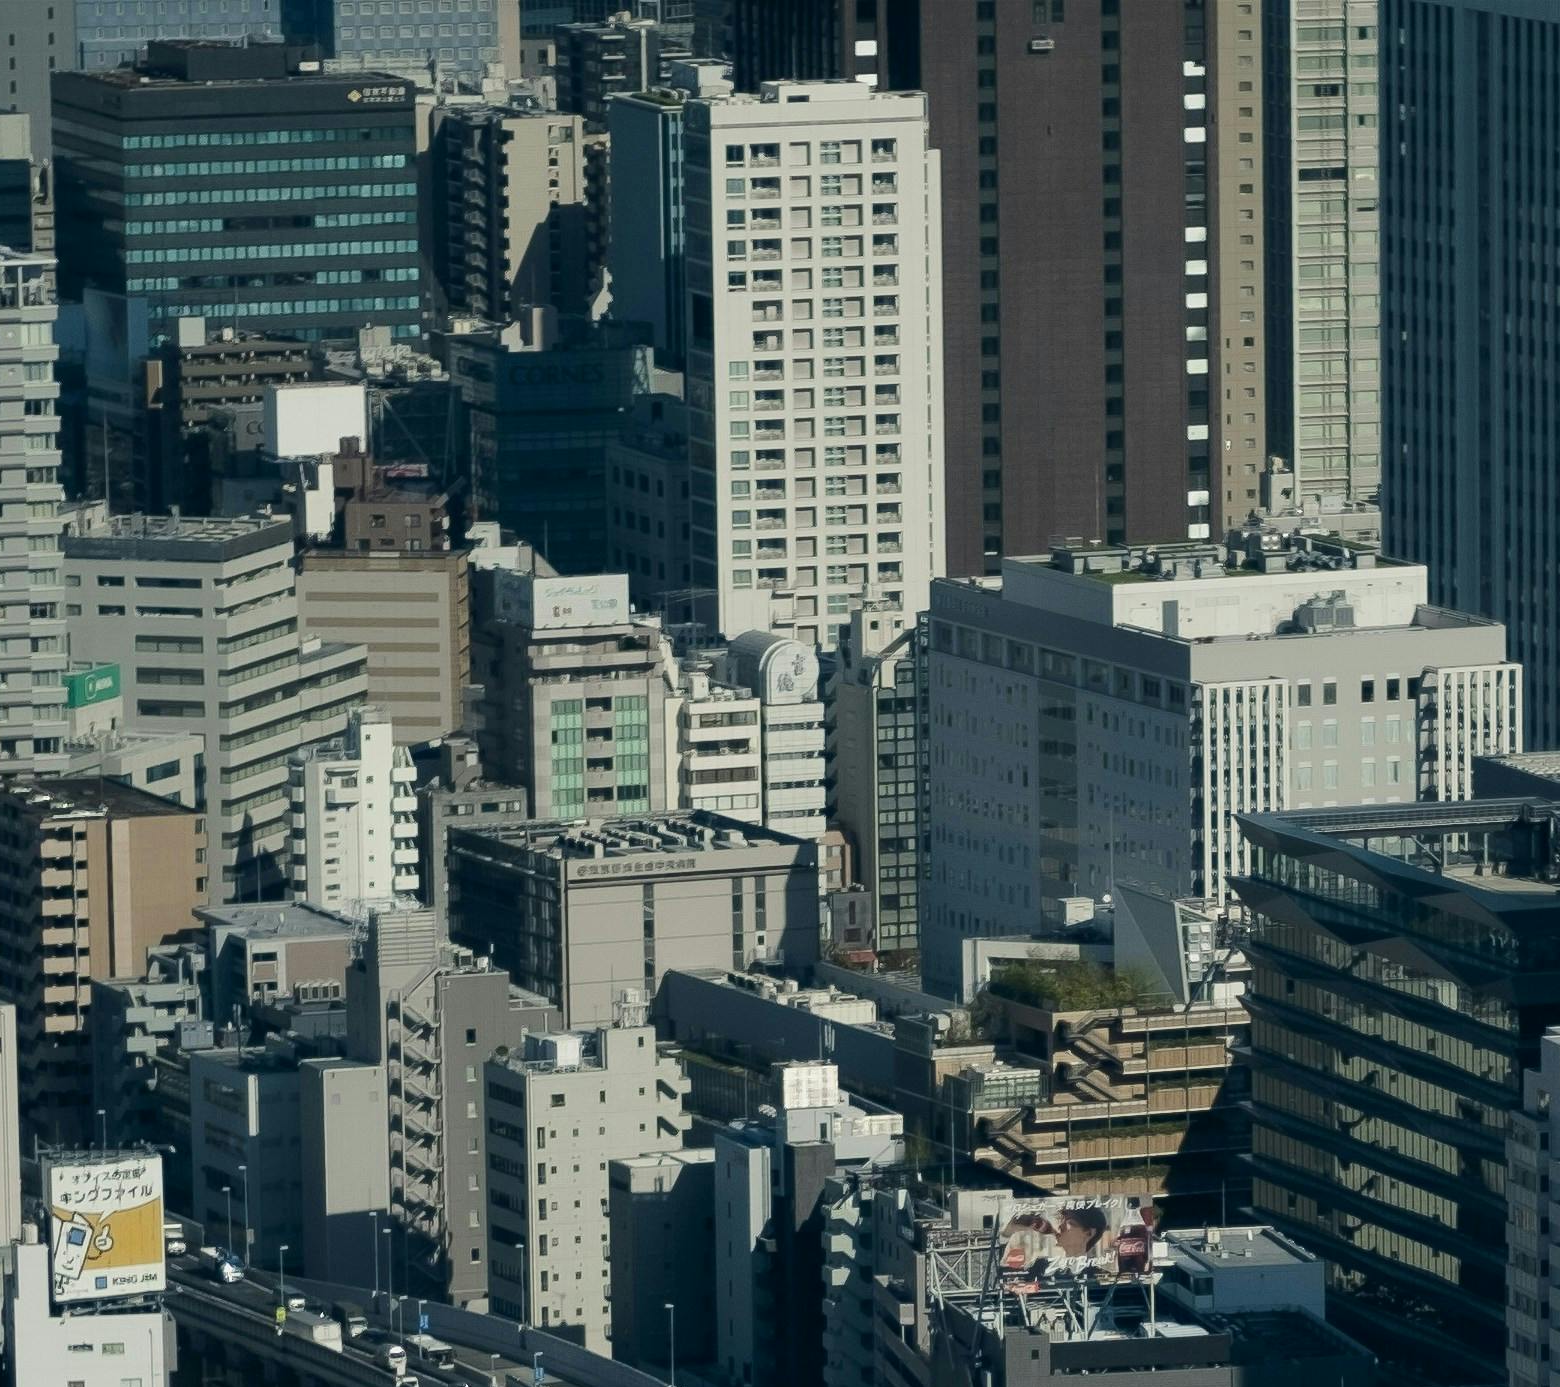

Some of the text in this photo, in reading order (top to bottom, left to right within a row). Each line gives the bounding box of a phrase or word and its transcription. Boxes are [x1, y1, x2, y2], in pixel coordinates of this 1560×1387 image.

[60, 1184, 153, 1204] キングファイル
